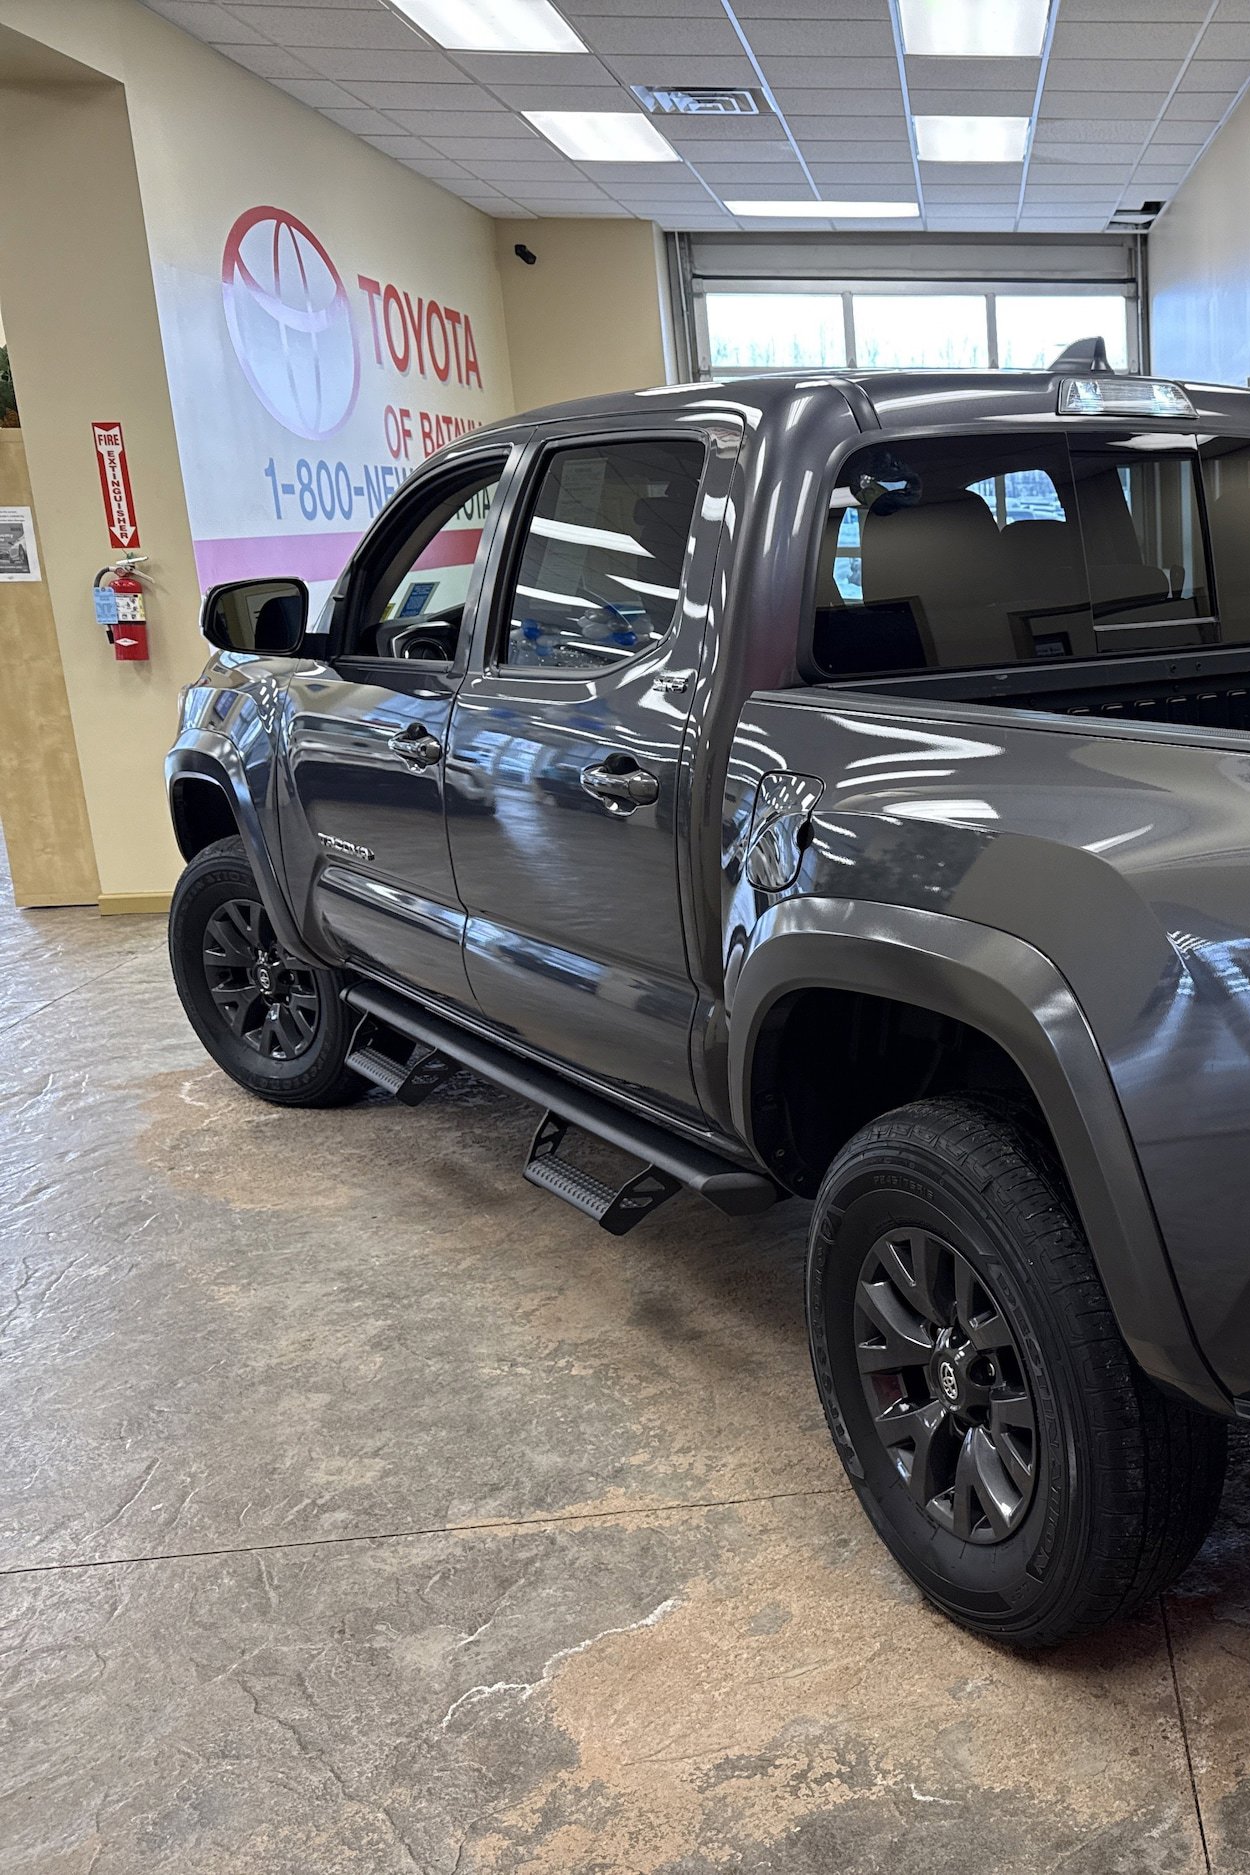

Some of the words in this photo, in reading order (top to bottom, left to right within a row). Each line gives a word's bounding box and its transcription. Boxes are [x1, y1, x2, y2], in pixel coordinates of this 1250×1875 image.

[357, 274, 483, 389] TOYOTA
[97, 434, 120, 446] FIRE
[384, 404, 412, 460] OF
[107, 450, 129, 539] EXTINGUISHER
